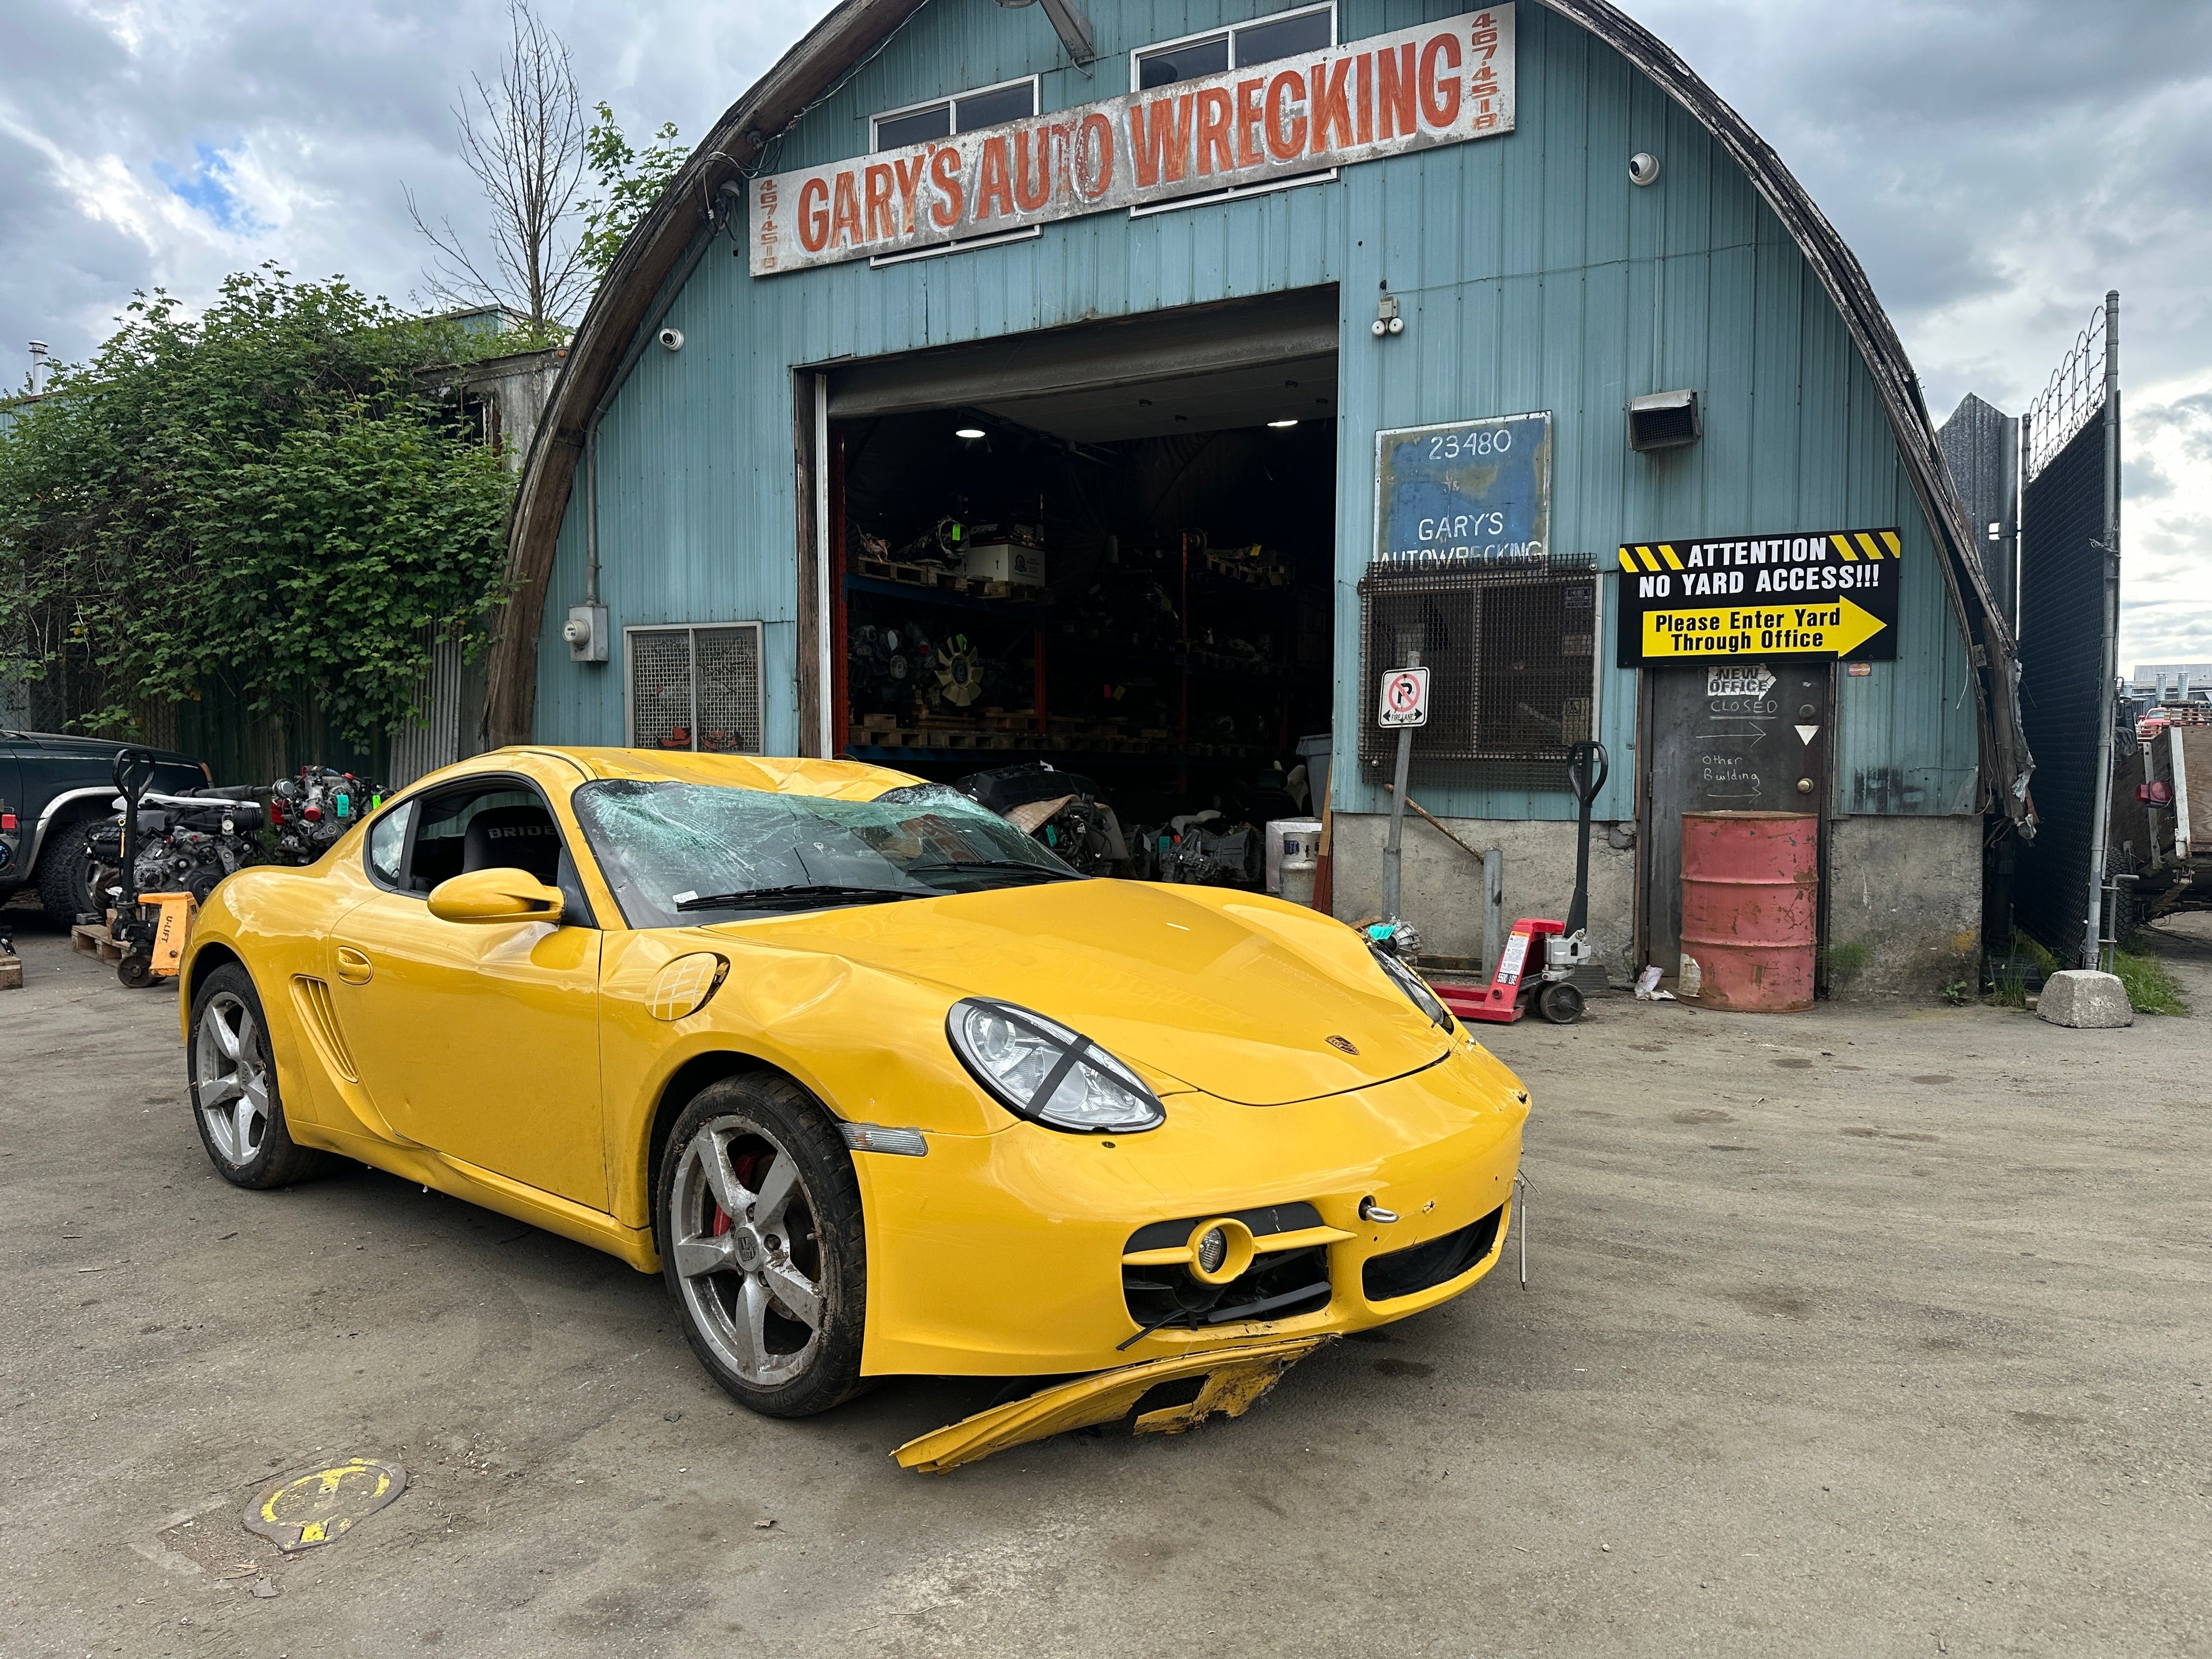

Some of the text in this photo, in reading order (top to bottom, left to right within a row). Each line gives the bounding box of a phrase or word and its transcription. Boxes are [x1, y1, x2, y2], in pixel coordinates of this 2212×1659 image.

[798, 33, 1461, 252] GARY'S AUTO WRECKING
[1429, 429, 1512, 460] 23480
[1418, 512, 1503, 541] GARY'S
[1687, 537, 1826, 567] ATTENTION
[1639, 564, 1879, 598] NO YARD ACCESS!!!
[1656, 607, 1840, 632] Please Enter Yard
[1671, 629, 1823, 653] Through Office
[1717, 667, 1760, 680] NEW
[1709, 680, 1768, 693] OFFICE
[1710, 699, 1778, 714] CLOSED
[1703, 768, 1760, 787] Building
[488, 825, 558, 839] BRIDE
[161, 915, 173, 944] U-LIFT
